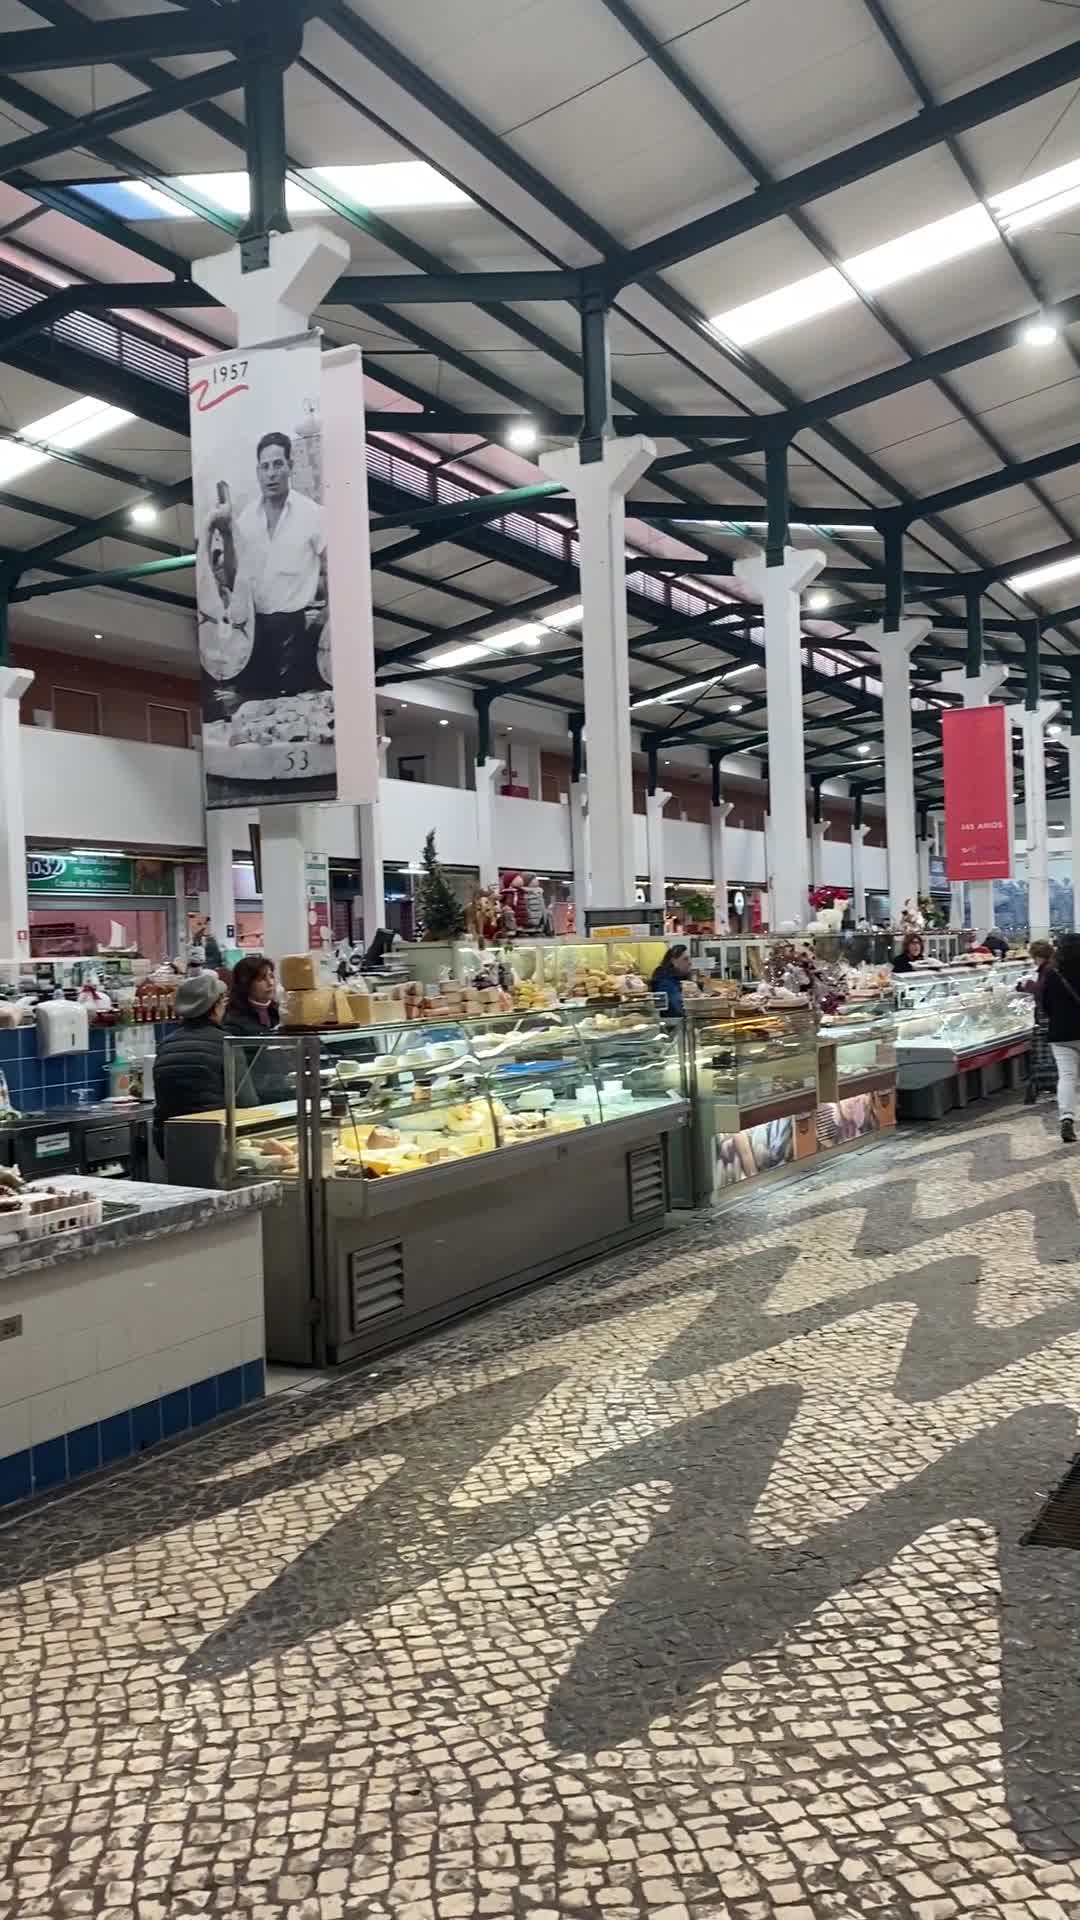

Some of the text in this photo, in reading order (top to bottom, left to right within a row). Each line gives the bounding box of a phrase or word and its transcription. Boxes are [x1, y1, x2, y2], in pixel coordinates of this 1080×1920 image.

[212, 361, 249, 385] 1957
[285, 750, 309, 771] 53
[977, 822, 1003, 830] ANOS
